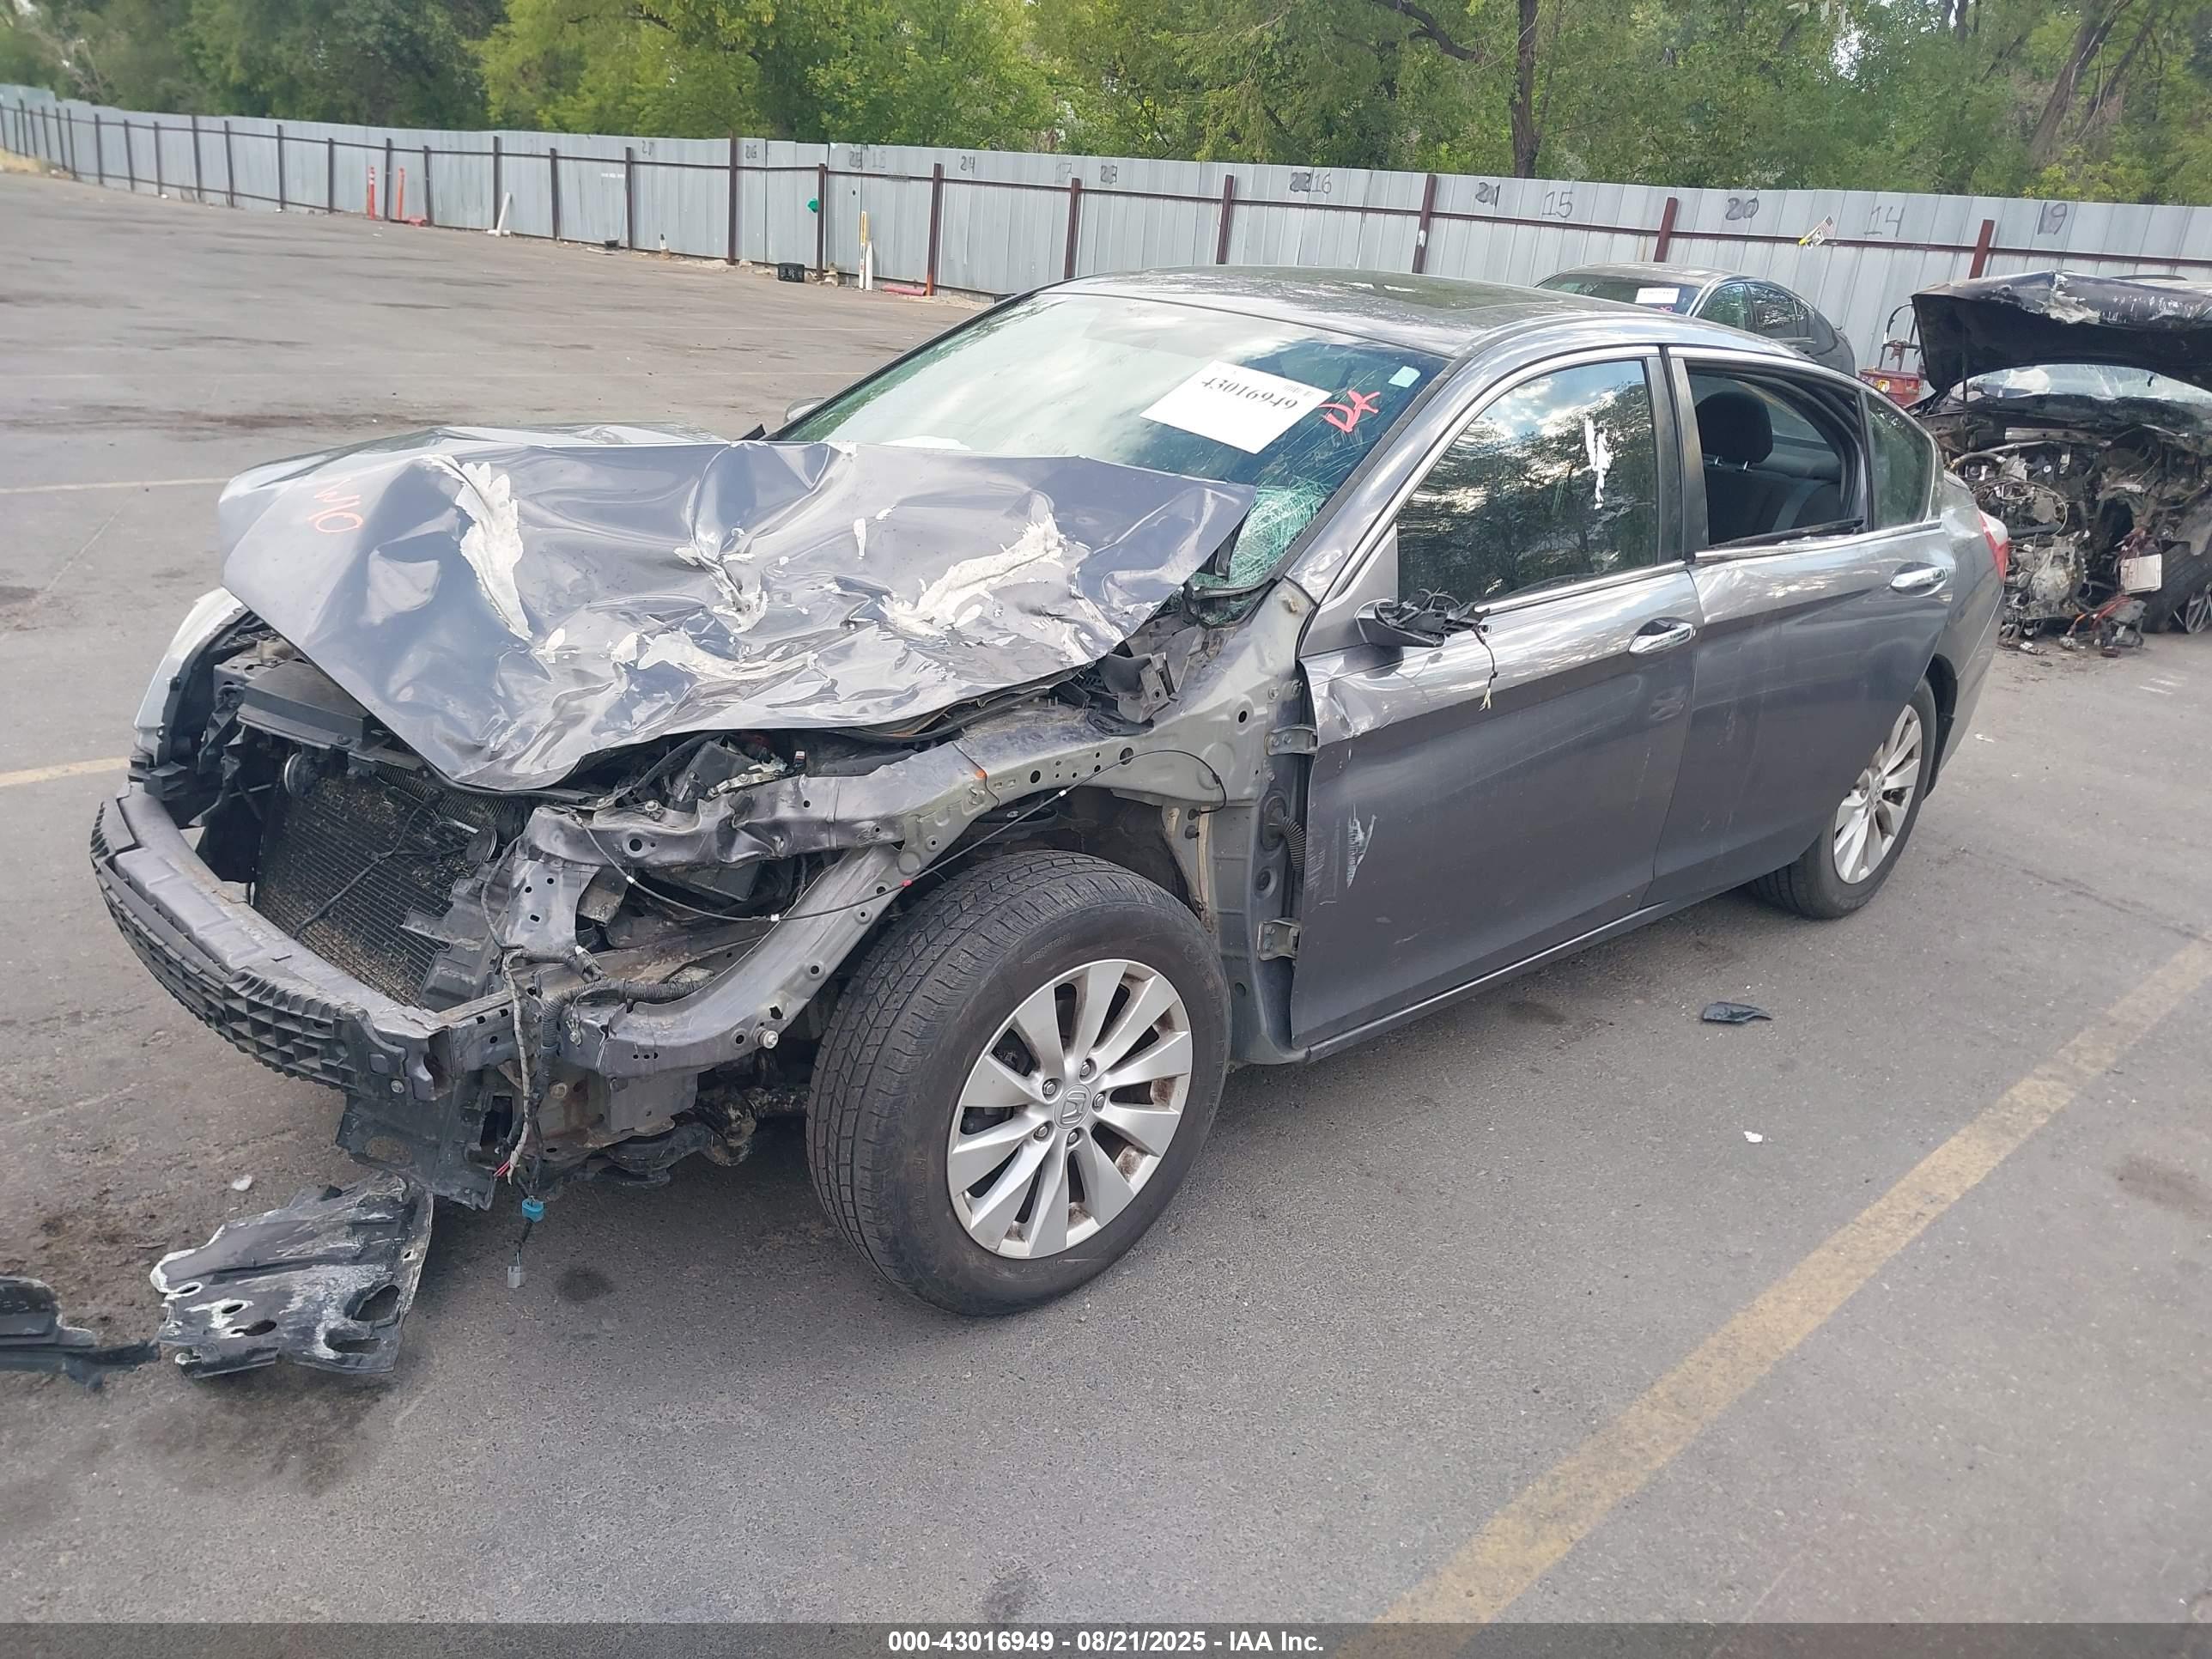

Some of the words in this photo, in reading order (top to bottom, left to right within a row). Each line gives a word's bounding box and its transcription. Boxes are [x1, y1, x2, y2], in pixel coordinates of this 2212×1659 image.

[960, 155, 976, 174] 24
[1312, 171, 1332, 194] 16
[1541, 190, 1574, 218] 15
[1725, 197, 1759, 221] 20
[1863, 205, 1906, 239] 14
[2037, 201, 2069, 237] 19
[1201, 377, 1299, 410] 43016949
